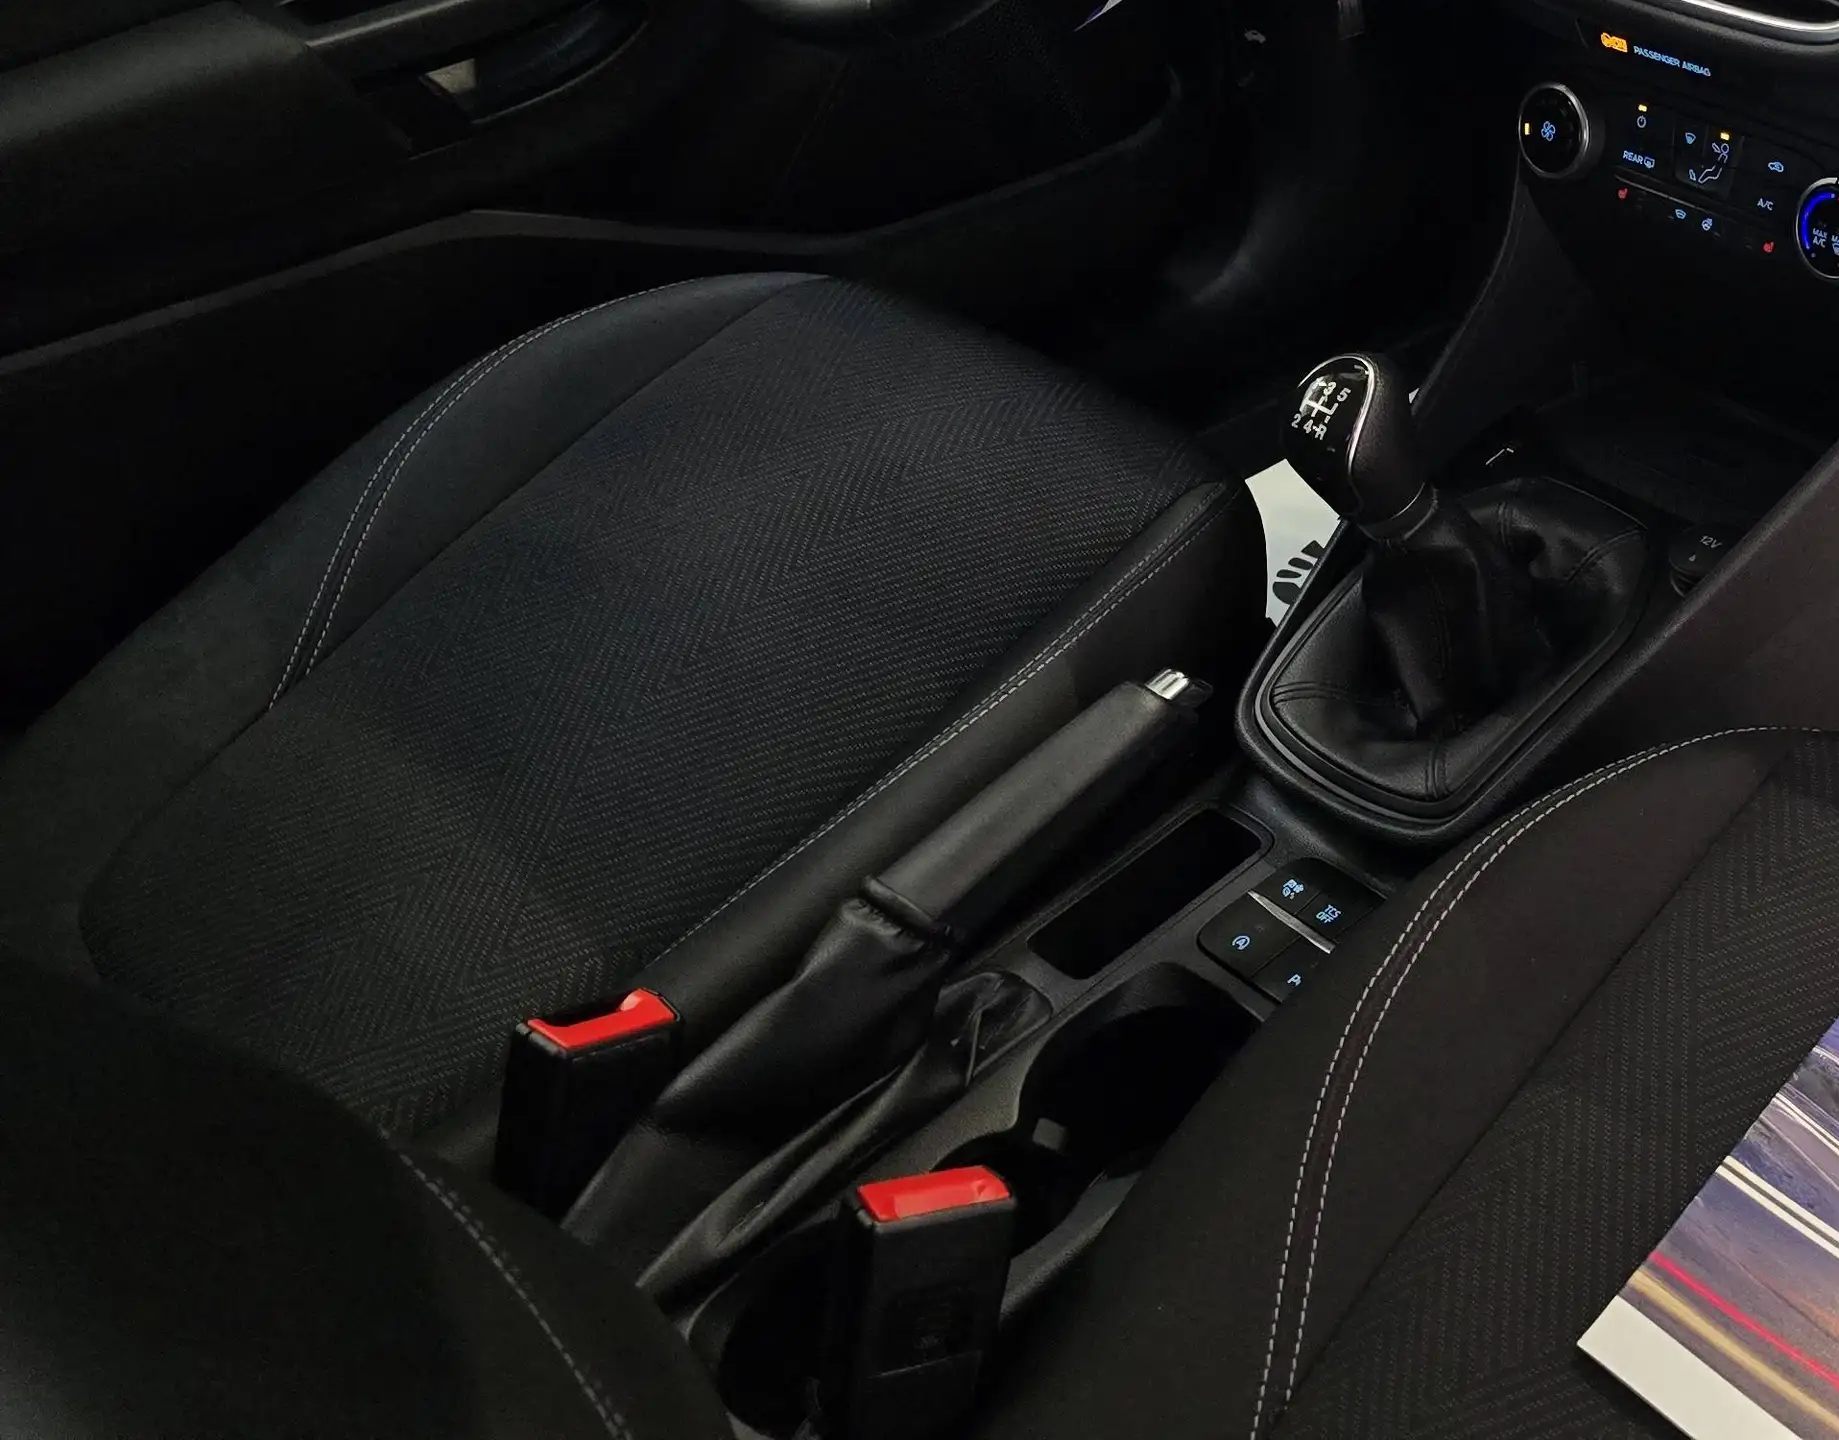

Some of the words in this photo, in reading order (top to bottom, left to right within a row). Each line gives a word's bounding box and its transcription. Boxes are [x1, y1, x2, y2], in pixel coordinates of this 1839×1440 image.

[1633, 45, 1681, 67] PASSENGER
[1681, 60, 1712, 77] AIRBAG
[1622, 150, 1644, 165] REAR
[1756, 198, 1774, 211] A/C
[1323, 381, 1337, 396] 3
[1336, 387, 1352, 402] 5
[1291, 413, 1302, 428] 2
[1302, 419, 1314, 434] 4
[1699, 534, 1723, 549] 12V
[1316, 911, 1334, 923] OFF
[1324, 904, 1341, 918] TCS
